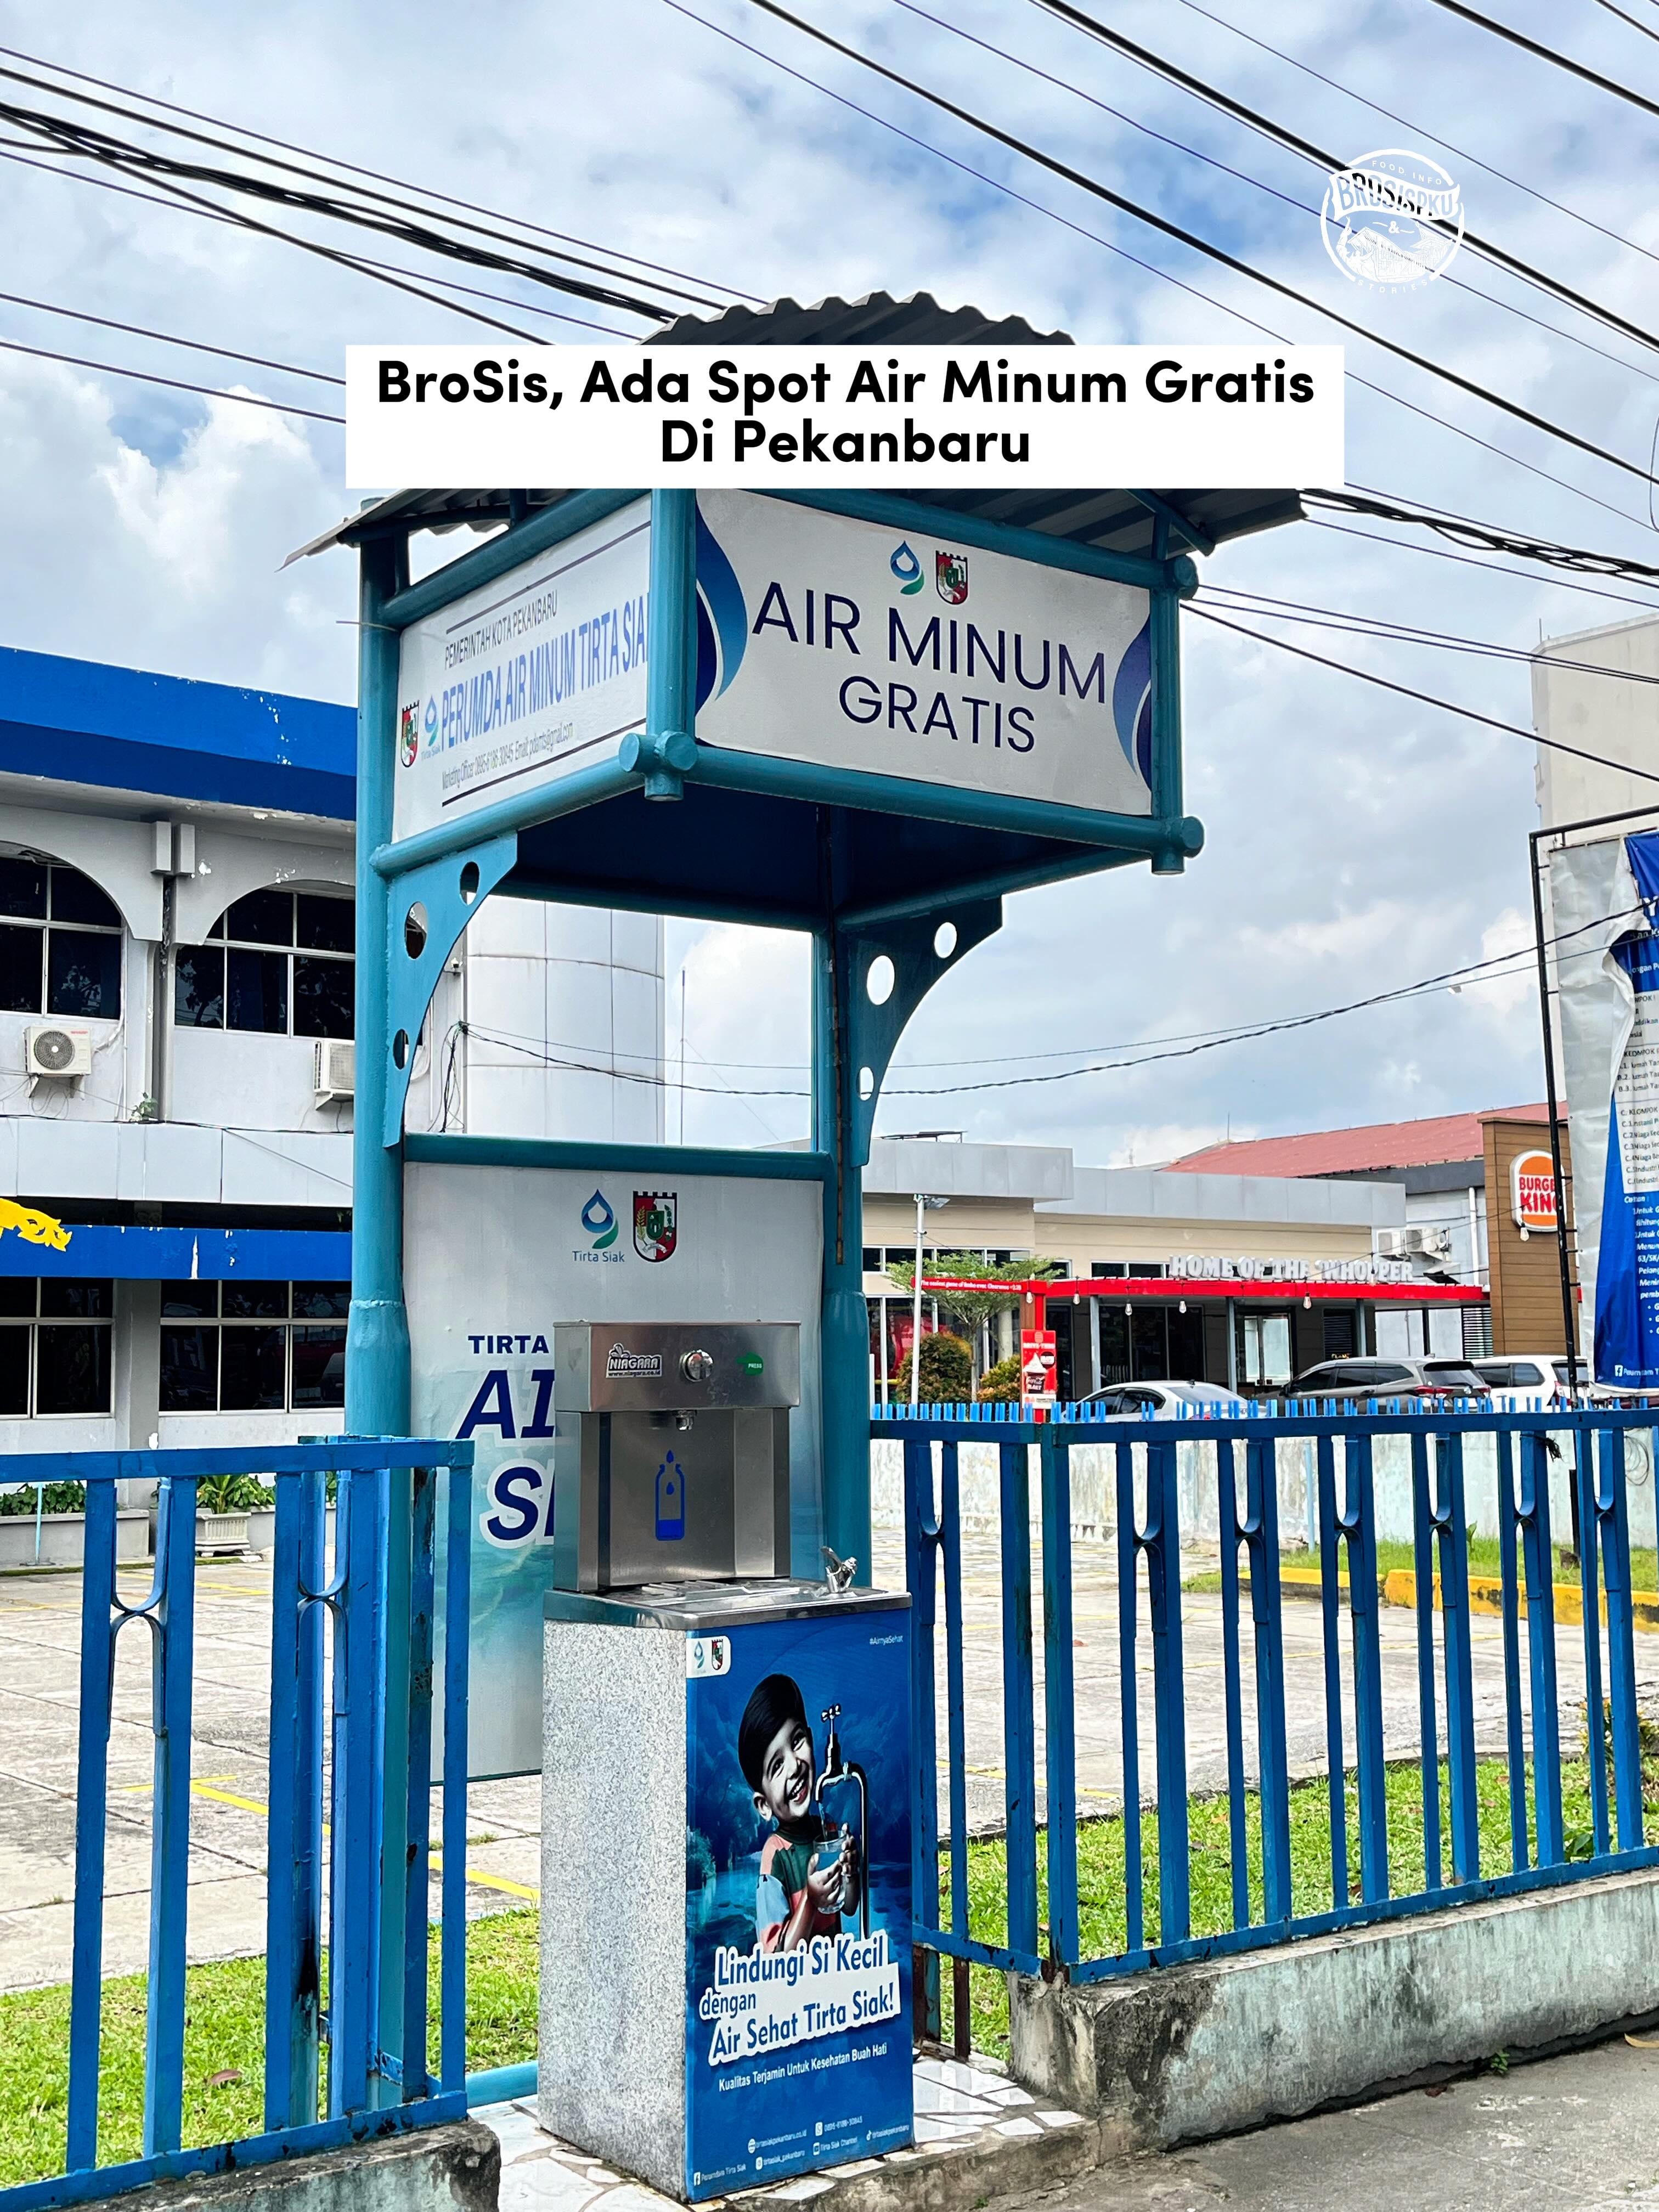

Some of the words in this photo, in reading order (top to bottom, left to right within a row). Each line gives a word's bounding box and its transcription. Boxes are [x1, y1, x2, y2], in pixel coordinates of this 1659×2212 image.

[445, 627, 492, 670] PEMERINTAH
[493, 615, 512, 648] KOTA
[514, 589, 558, 639] PEKANBARU
[752, 581, 861, 655] AIR
[888, 606, 1105, 704] MINUM
[441, 666, 501, 752] PERUMDA
[504, 653, 527, 725] AIR
[529, 629, 576, 714] MINUM
[579, 608, 619, 691] TIRTA
[623, 592, 650, 673] SIA
[839, 675, 1035, 753] GRATIS
[1519, 1177, 1555, 1192] BURGE
[572, 1250, 599, 1262] Tirta
[602, 1251, 625, 1262] Siak
[1169, 1255, 1233, 1279] HOME
[1238, 1255, 1264, 1279] OF
[1268, 1257, 1310, 1280] THE
[1315, 1260, 1414, 1283] WHOPPER
[467, 1335, 549, 1354] TIRTA
[609, 1357, 658, 1370] NIAGARA
[455, 1370, 555, 1440] AI
[487, 1466, 555, 1541] S
[719, 1945, 804, 1987] Lindungi
[812, 1941, 828, 1975] Si
[837, 1935, 883, 1972] Kecil
[701, 1992, 756, 2019] dengan
[713, 2026, 741, 2059] Air
[747, 2013, 798, 2049] Sehat
[803, 2003, 846, 2033] Tirta
[852, 1982, 894, 2021] Siak!
[719, 2075, 751, 2092] Kualitas
[753, 2067, 786, 2085] Terjamin
[787, 2061, 810, 2075] Untuk
[811, 2052, 850, 2070] Kesehatan
[852, 2047, 871, 2062] Buah
[872, 2042, 887, 2056] Hati
